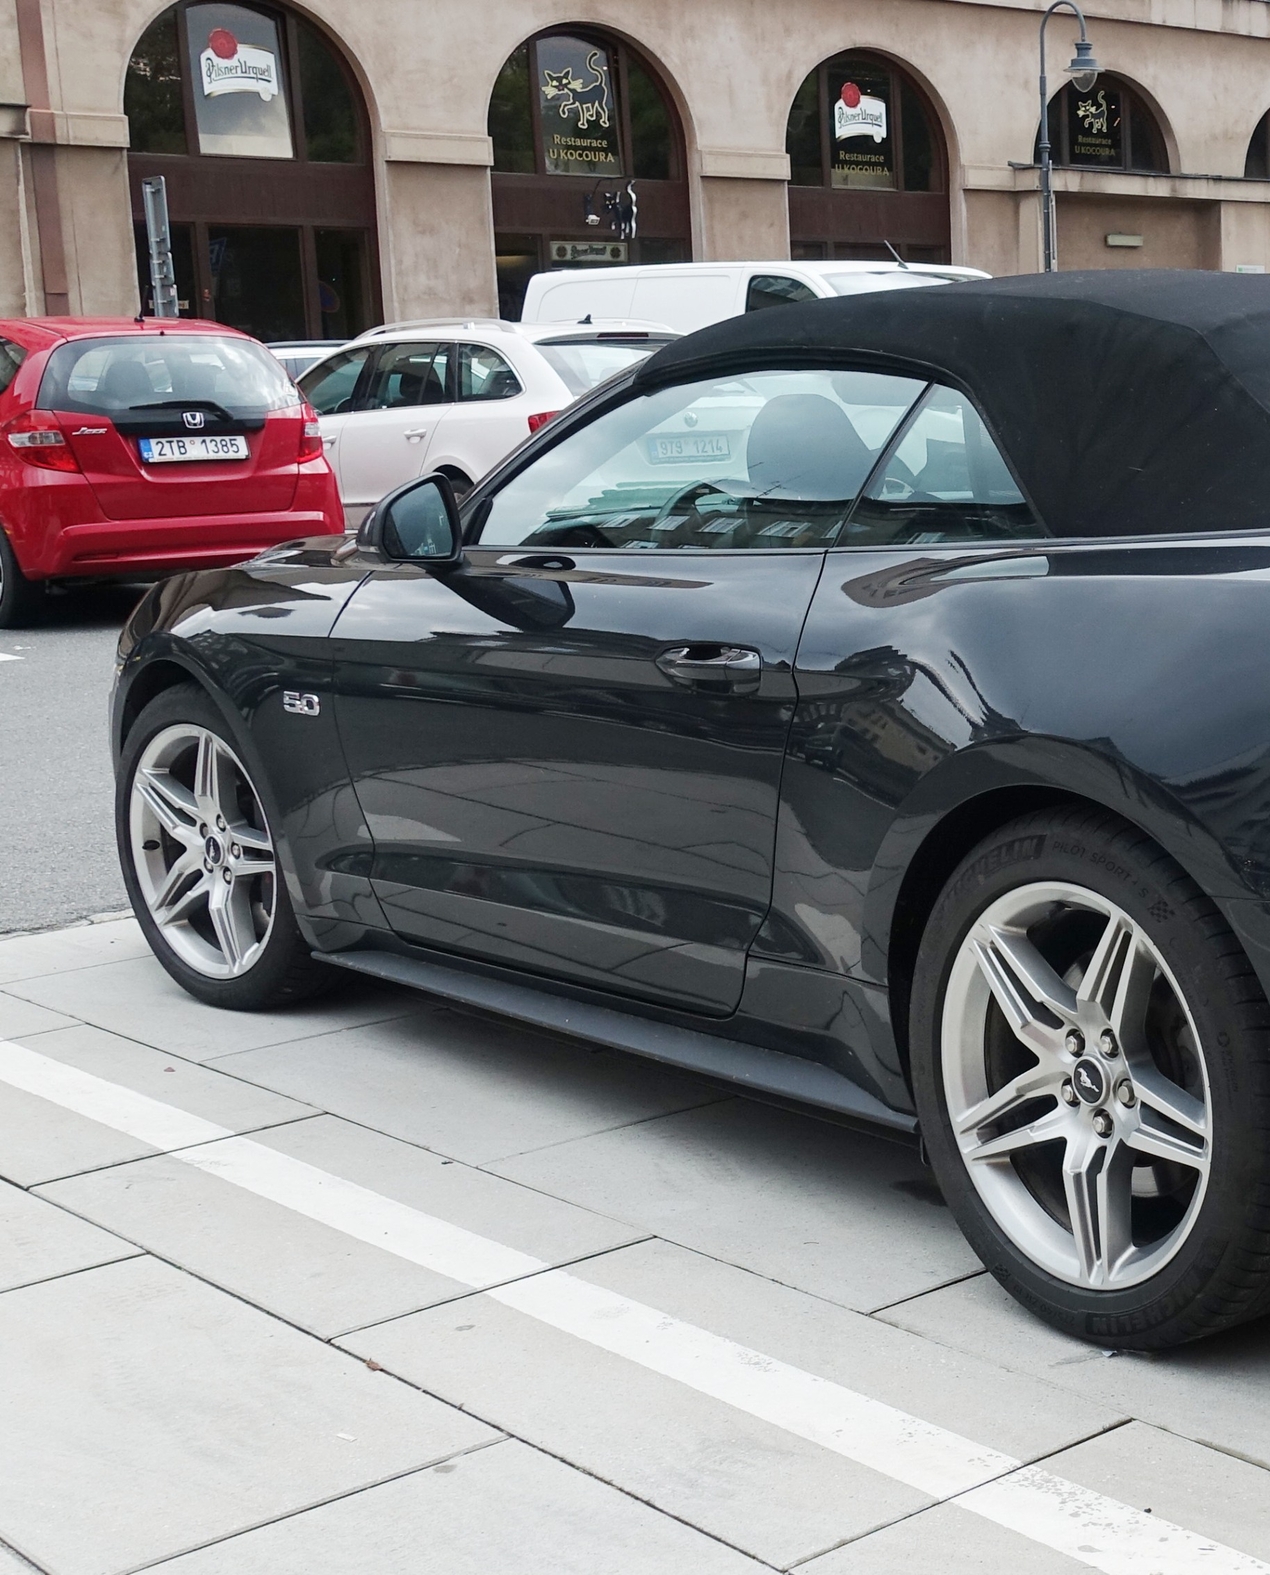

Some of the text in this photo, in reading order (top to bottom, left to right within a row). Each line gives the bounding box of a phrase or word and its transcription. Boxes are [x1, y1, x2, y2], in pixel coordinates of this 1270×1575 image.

[205, 57, 272, 84] Pilsner Urquell
[838, 106, 883, 128] Pilsner Urquell
[553, 133, 608, 148] Restaurace
[549, 148, 615, 163] U KOCOURA
[839, 150, 885, 163] Restaurace
[1074, 145, 1116, 156] U KOCOURA
[835, 163, 890, 176] U KOCOURA
[155, 438, 240, 457] 2TB 1385
[660, 439, 723, 455] 9T9 1214
[1052, 841, 1086, 858] PILOT
[1089, 851, 1132, 881] SPORT
[1138, 887, 1149, 898] S
